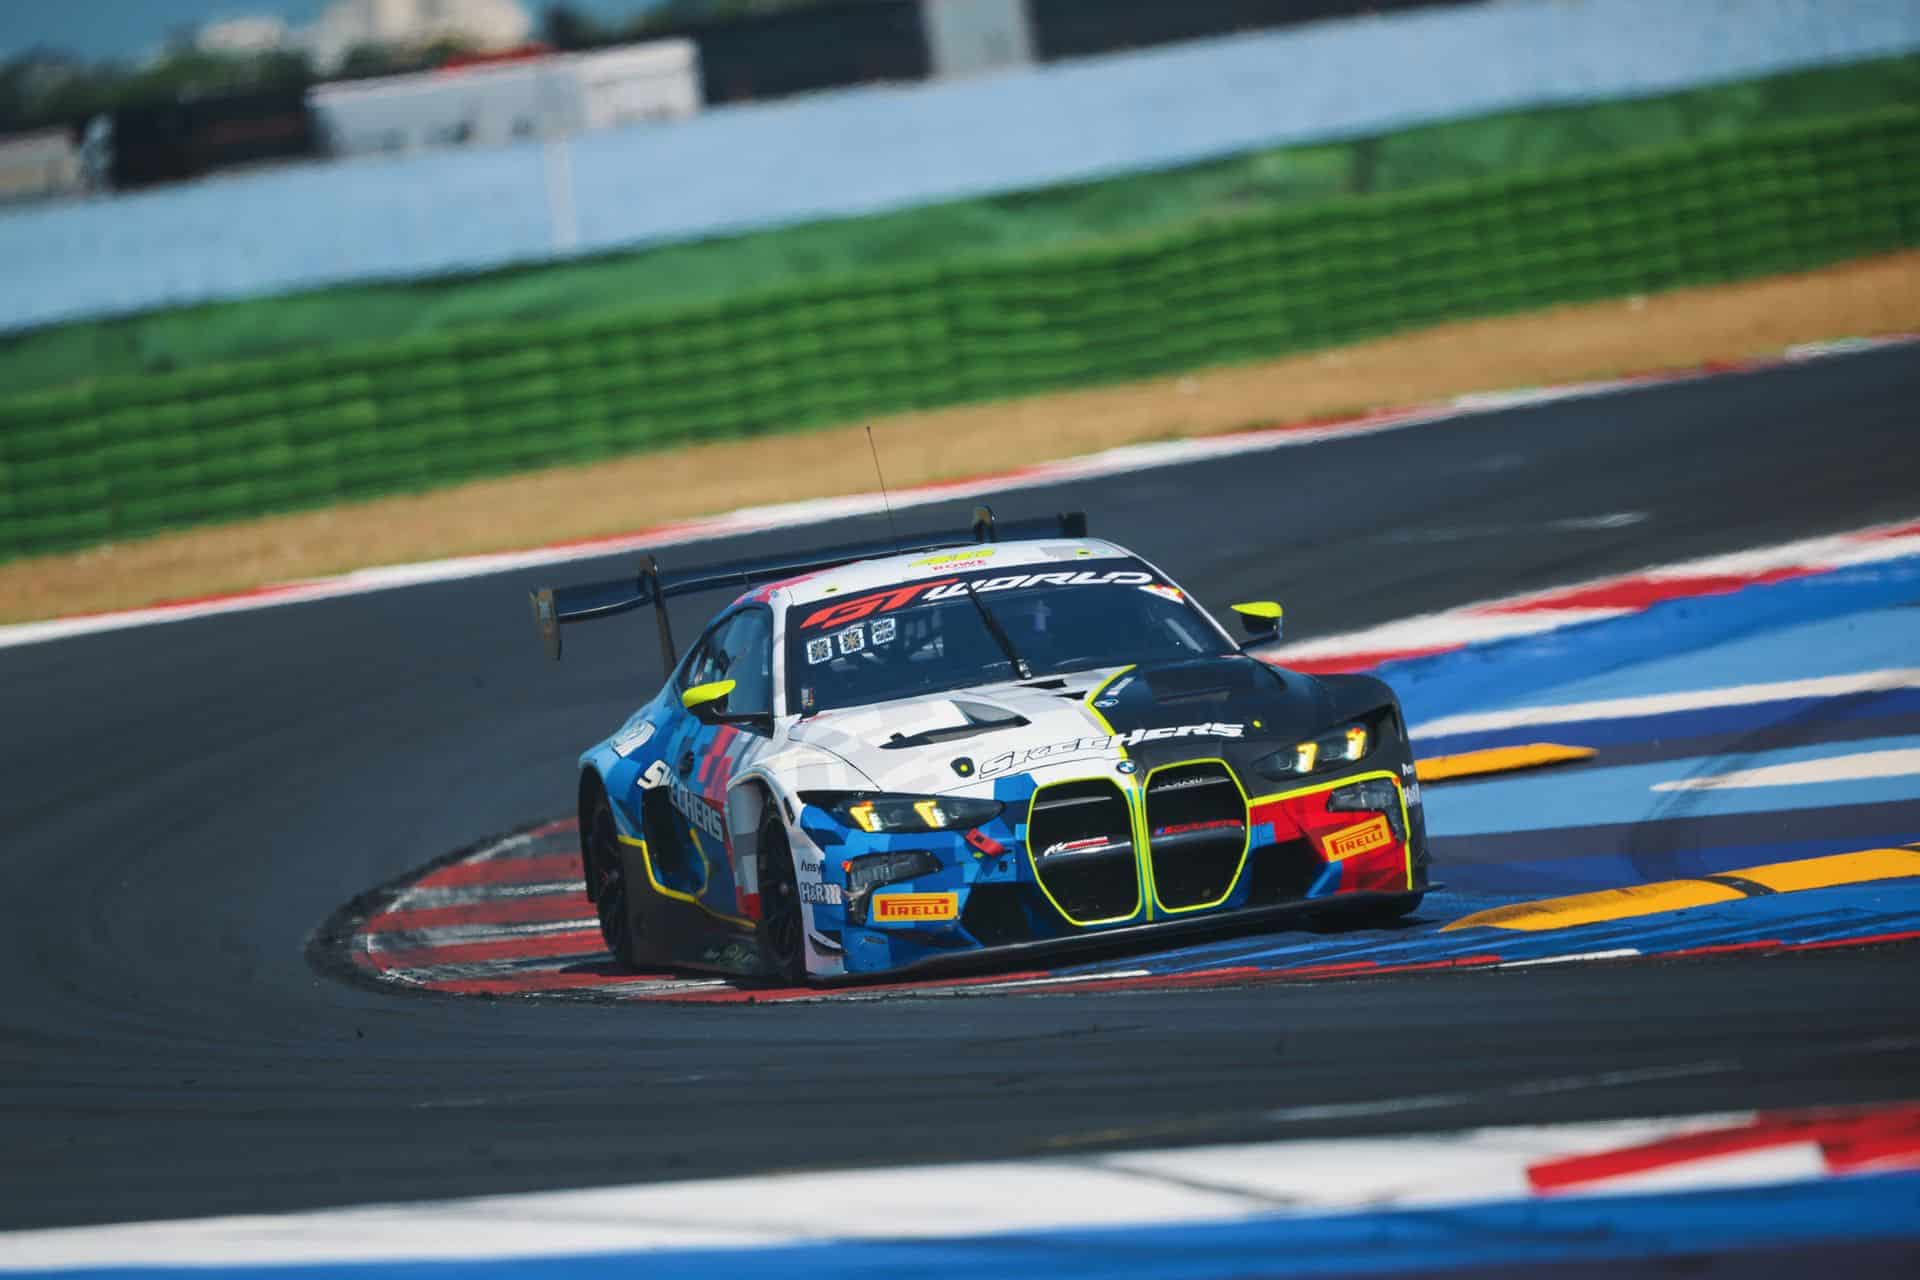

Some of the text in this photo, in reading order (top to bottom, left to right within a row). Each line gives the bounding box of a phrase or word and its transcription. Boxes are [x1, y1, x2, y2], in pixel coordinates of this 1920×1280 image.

[979, 722, 1244, 779] SKECHERS
[1329, 823, 1383, 857] PIRELLI
[880, 898, 949, 916] PIRELLI
